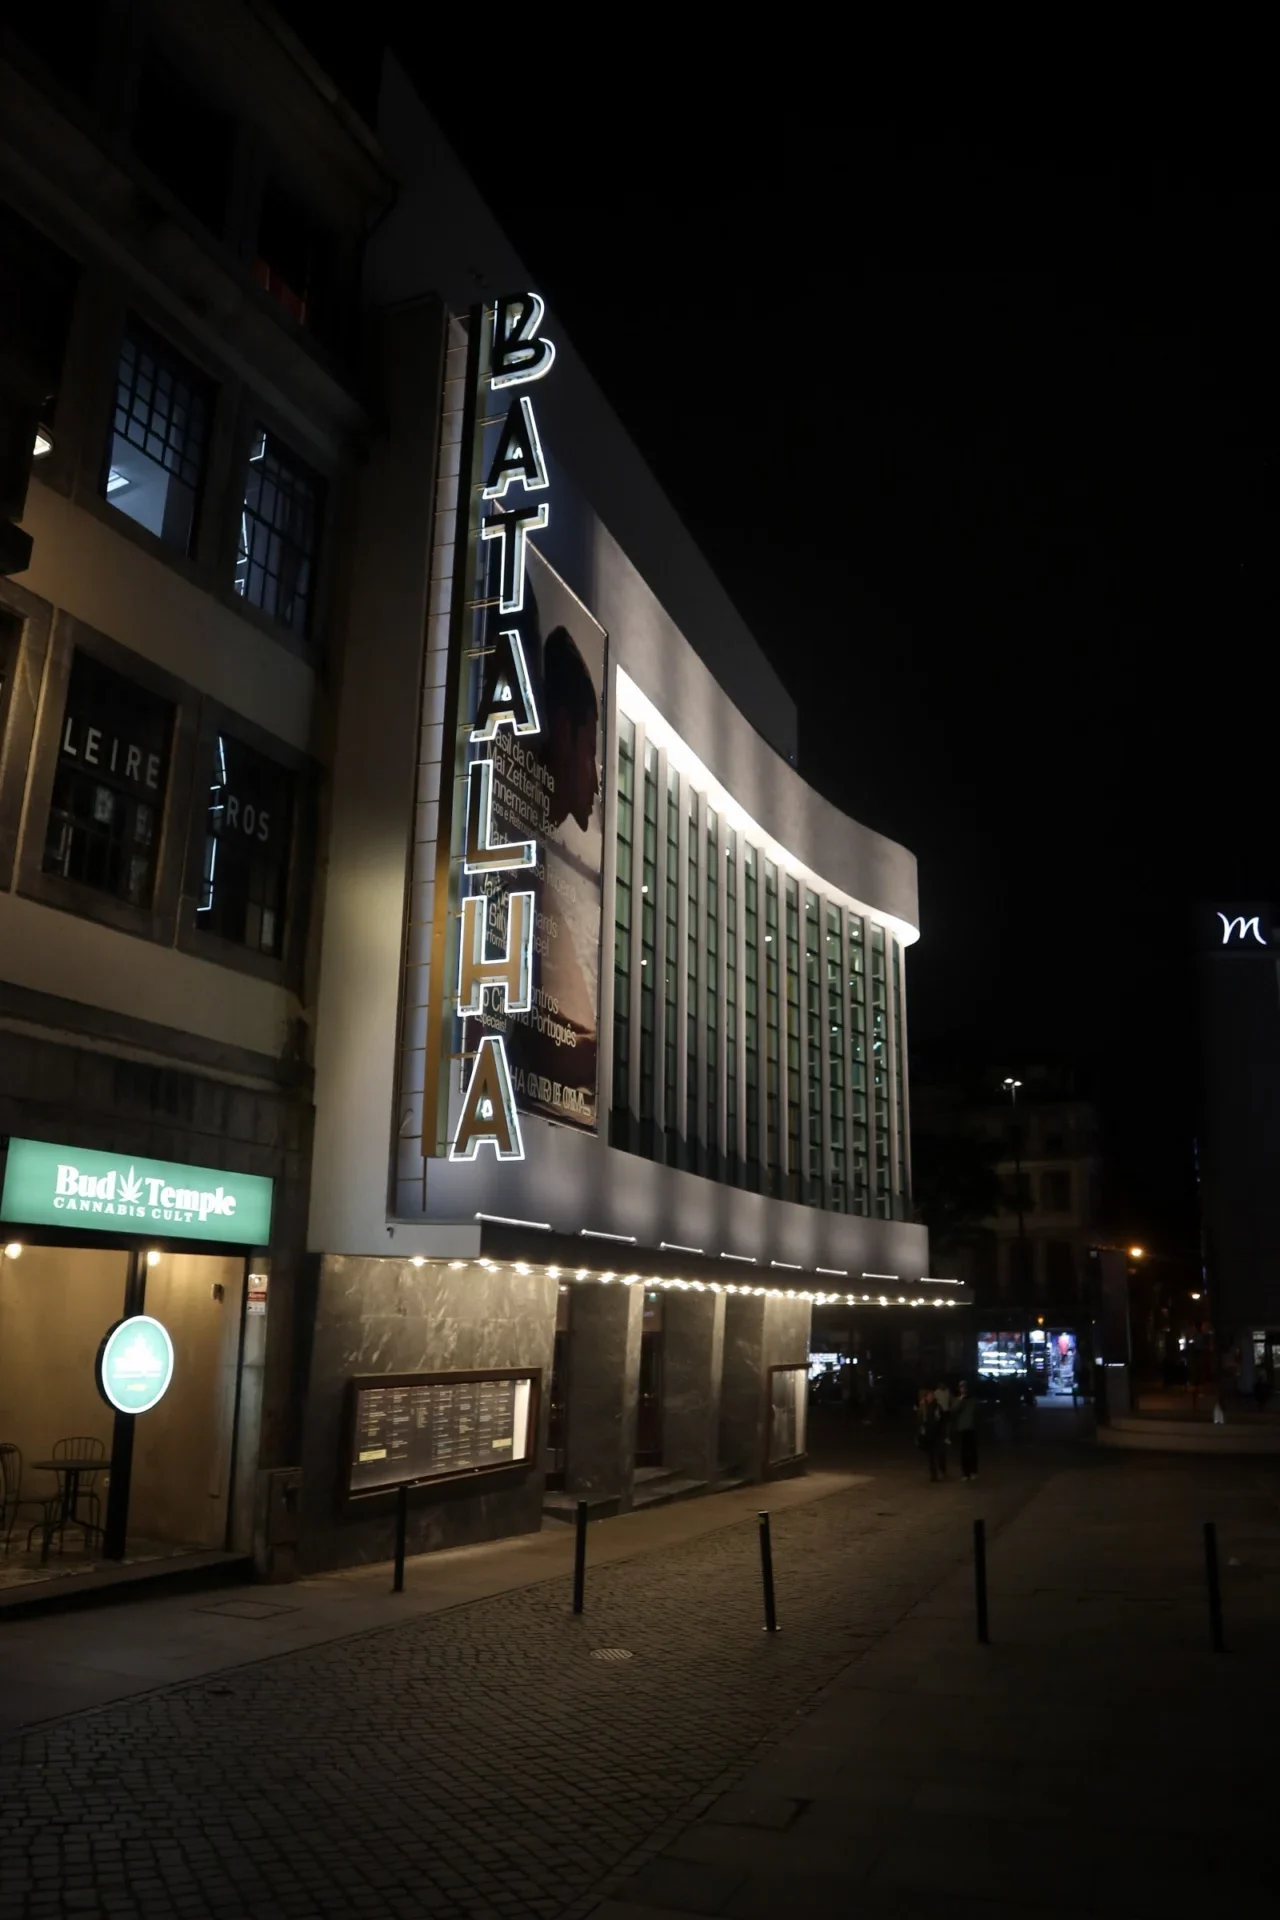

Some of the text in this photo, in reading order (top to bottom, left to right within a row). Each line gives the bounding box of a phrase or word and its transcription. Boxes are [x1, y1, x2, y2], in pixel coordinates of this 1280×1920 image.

[63, 717, 160, 789] LEIRE
[447, 291, 557, 1165] BATALHA
[526, 750, 555, 794] Cunha
[530, 1006, 577, 1049] Português
[53, 1196, 193, 1223] CANNABIS CULT
[55, 1164, 237, 1222] Bud Temple
